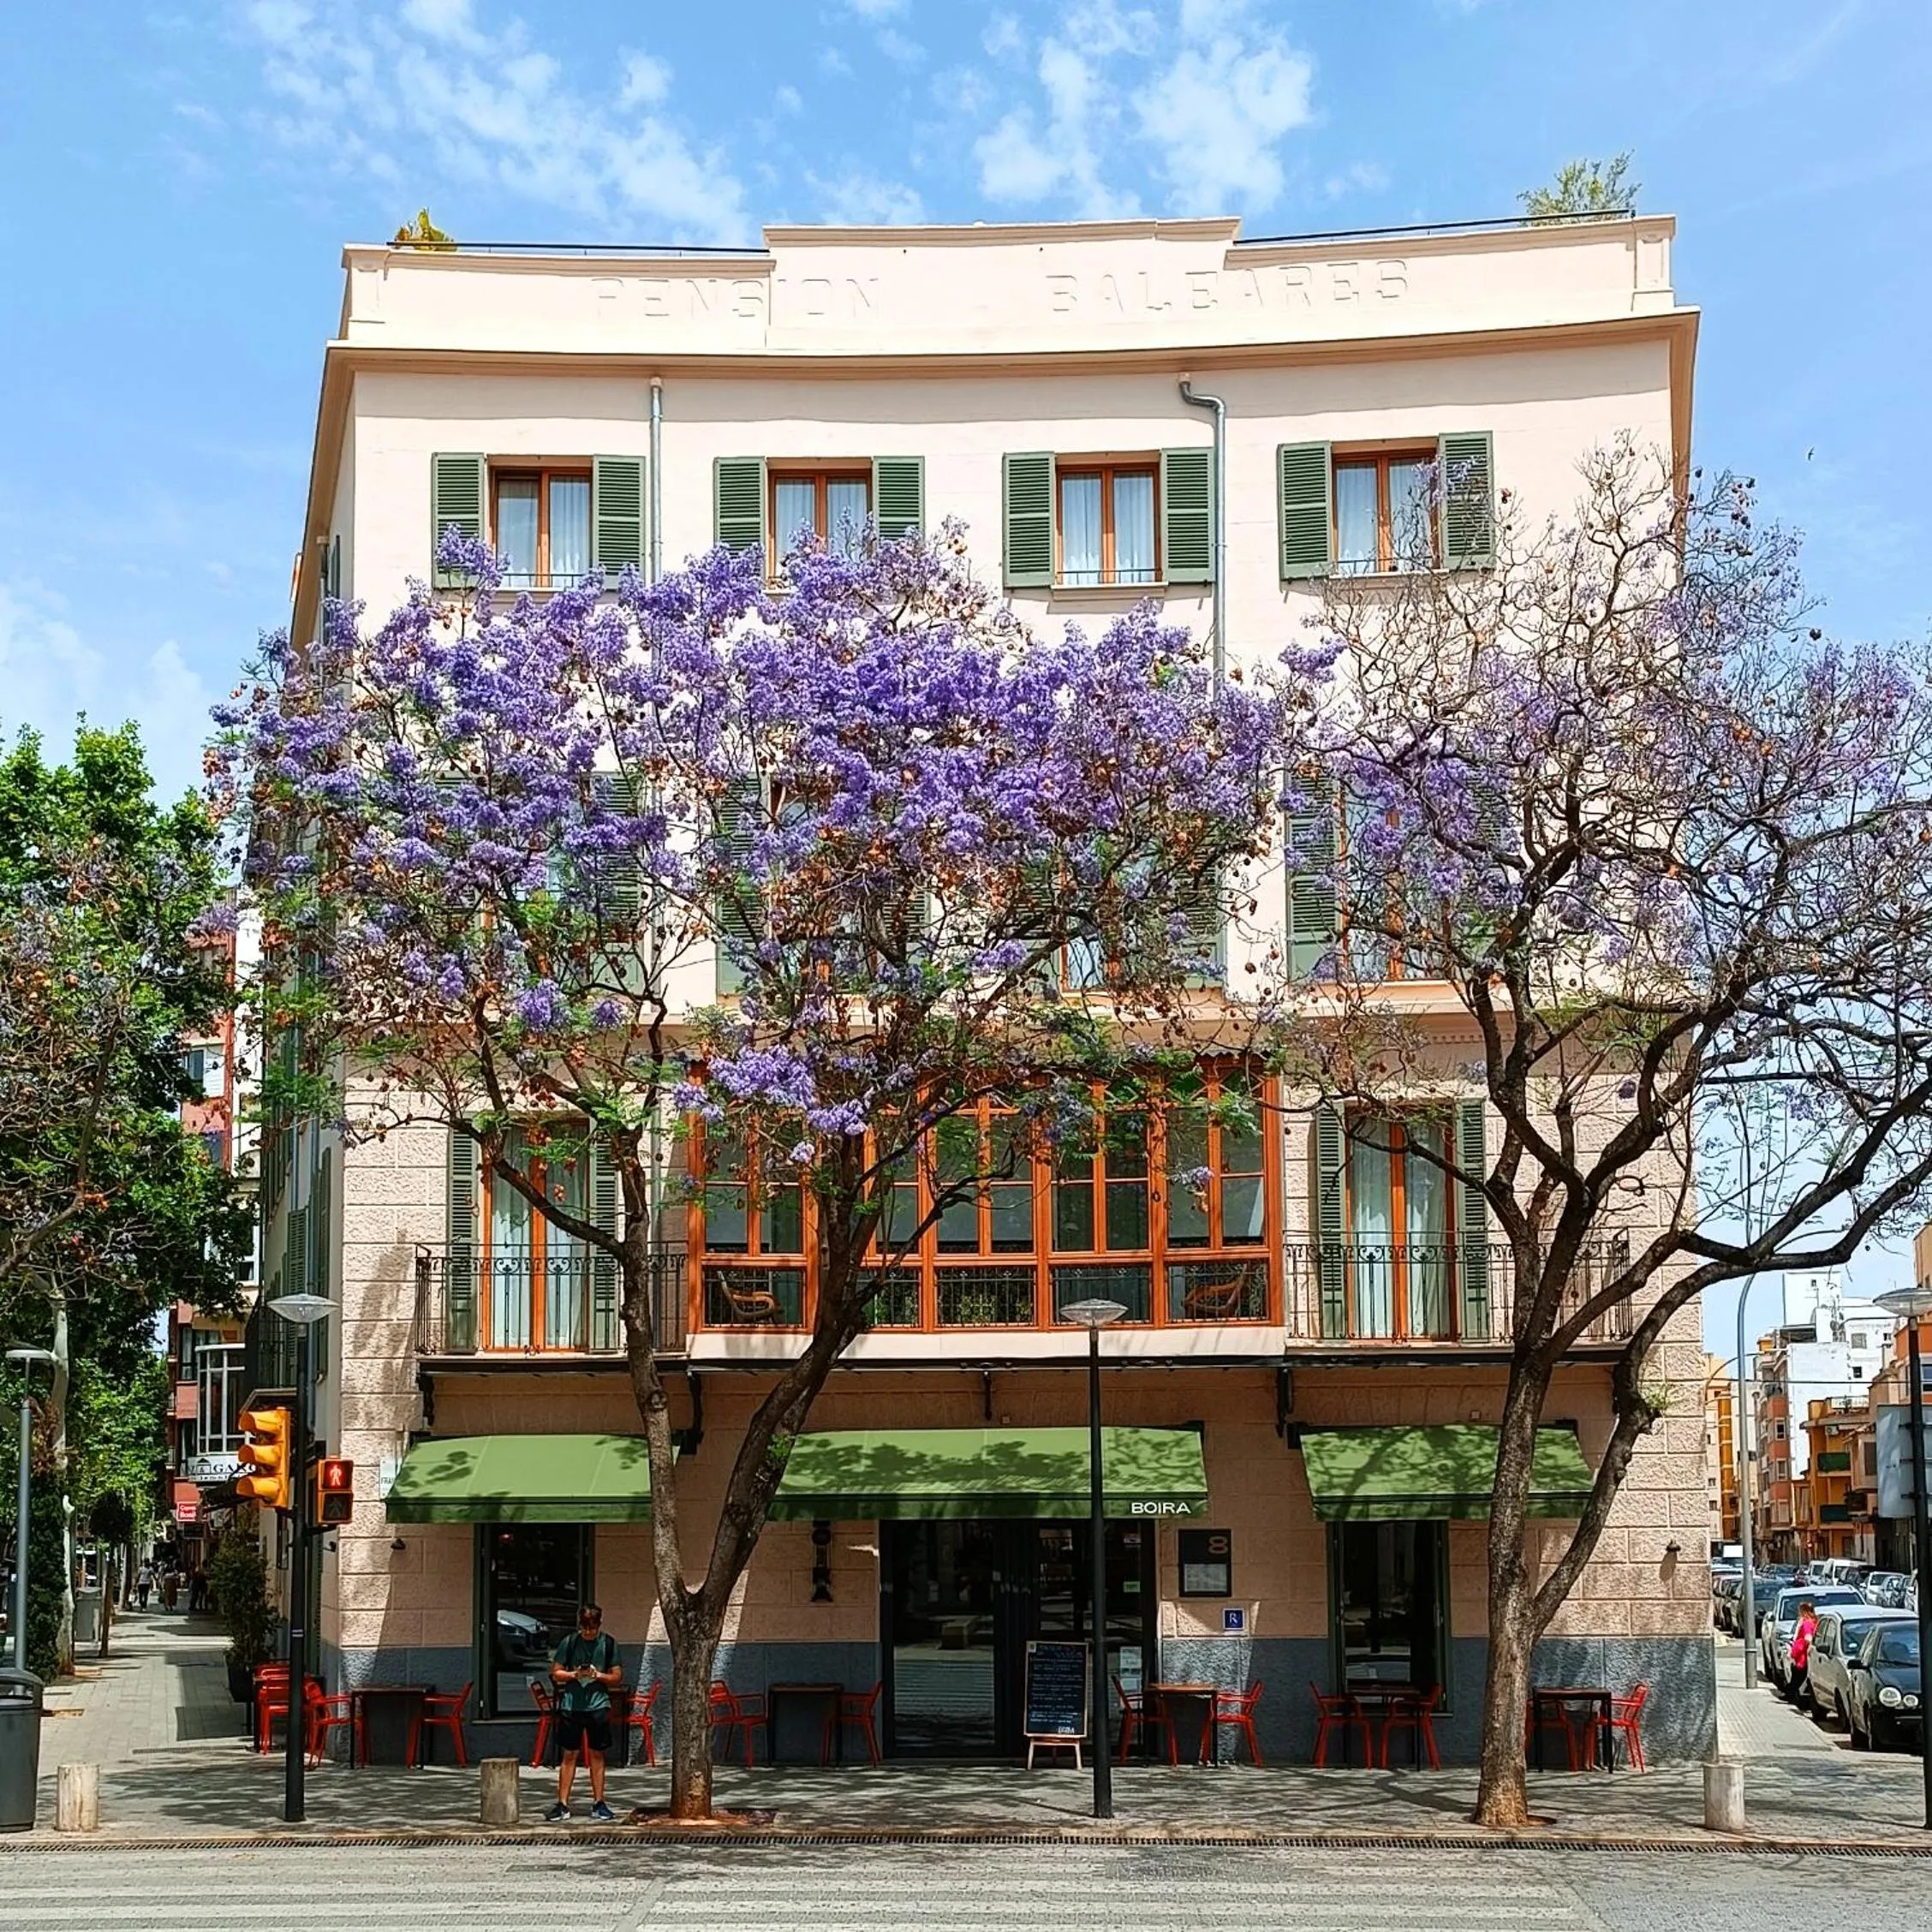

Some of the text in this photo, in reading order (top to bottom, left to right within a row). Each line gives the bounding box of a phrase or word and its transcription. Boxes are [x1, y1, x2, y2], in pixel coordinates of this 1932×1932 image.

[1046, 259, 1408, 312] BALEARES
[1131, 1501, 1191, 1514] BOIRA
[1208, 1535, 1229, 1554] 8
[1229, 1613, 1237, 1624] R
